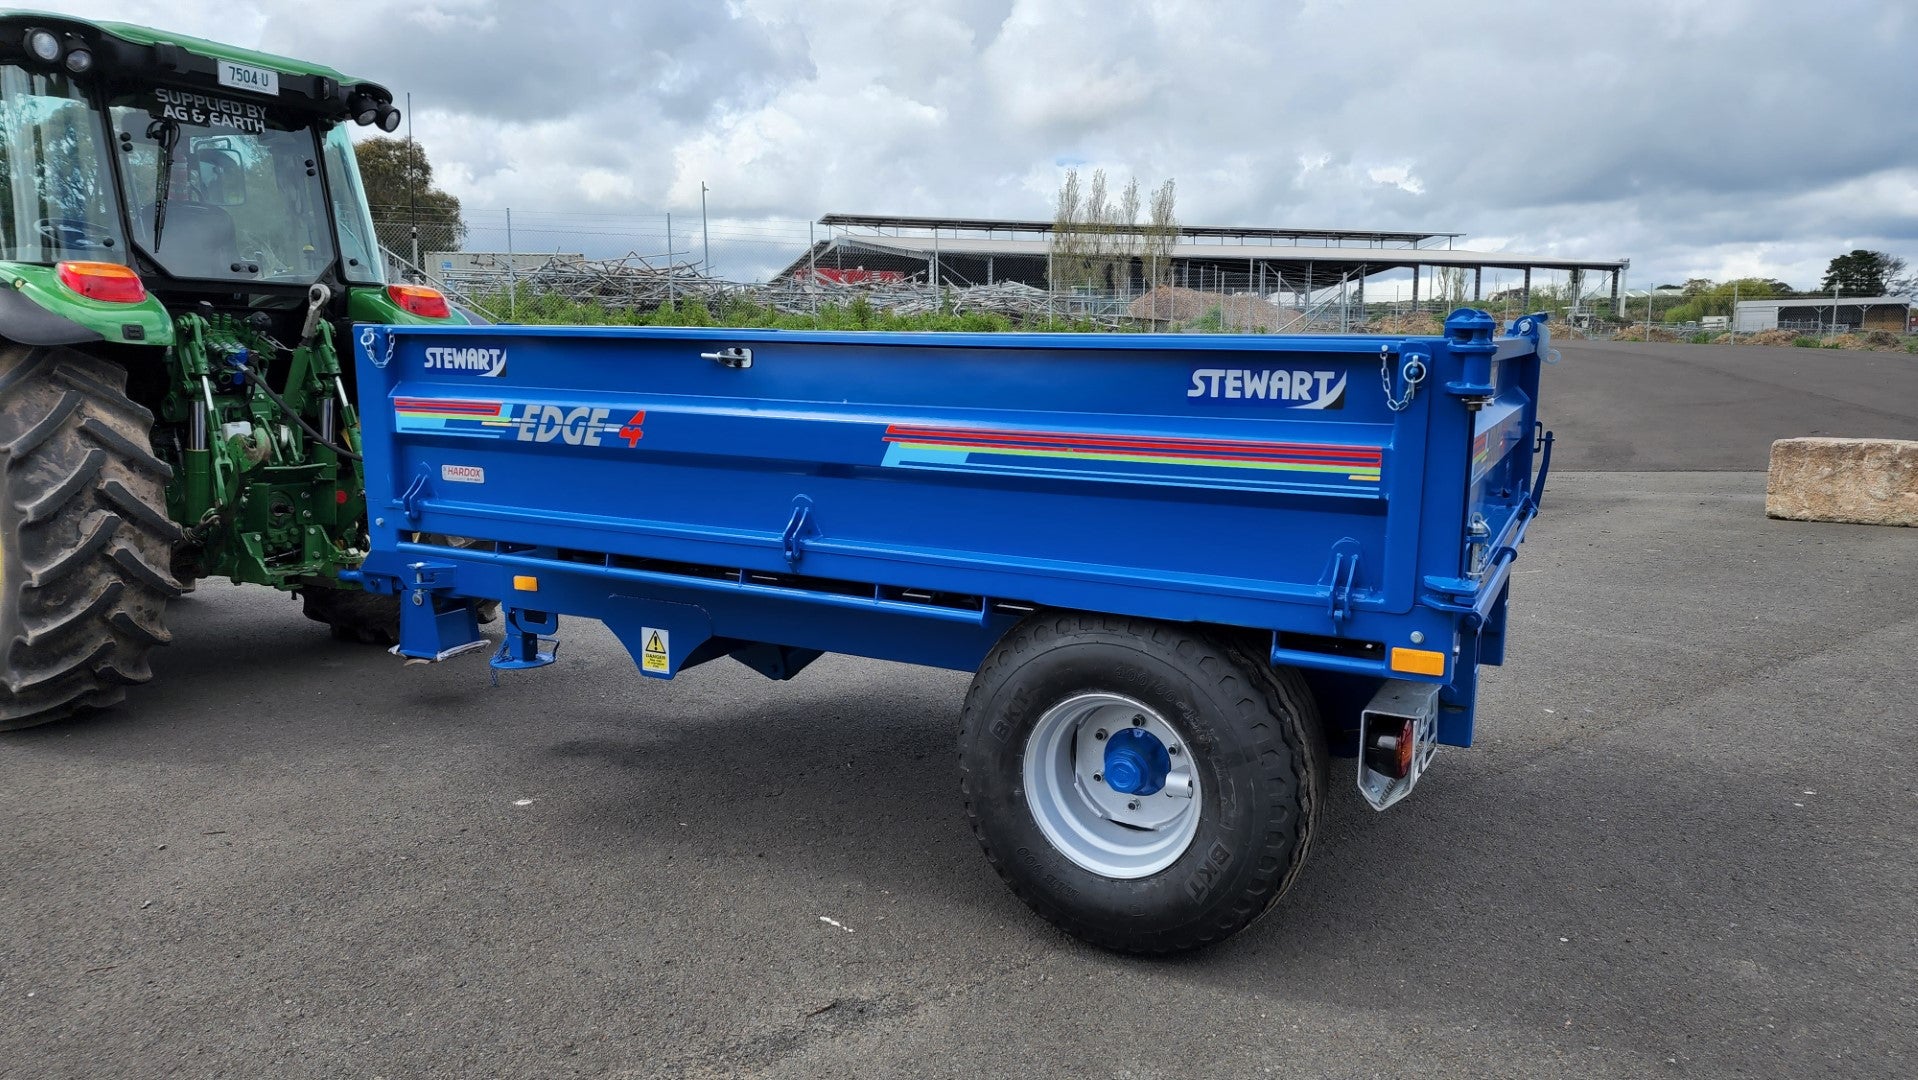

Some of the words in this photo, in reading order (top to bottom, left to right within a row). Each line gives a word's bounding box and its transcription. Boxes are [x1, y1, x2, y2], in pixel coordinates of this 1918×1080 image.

[228, 65, 258, 85] 7504
[261, 72, 269, 87] U
[155, 88, 242, 115] SUPPLIED
[245, 103, 267, 120] BY
[163, 104, 189, 121] AG
[191, 108, 206, 123] &
[209, 112, 266, 133] EARTH
[424, 347, 506, 377] STEWART
[1187, 368, 1347, 410] STEWART
[516, 403, 611, 447] EDGE
[619, 409, 647, 448] 4
[447, 467, 481, 477] HARDOX
